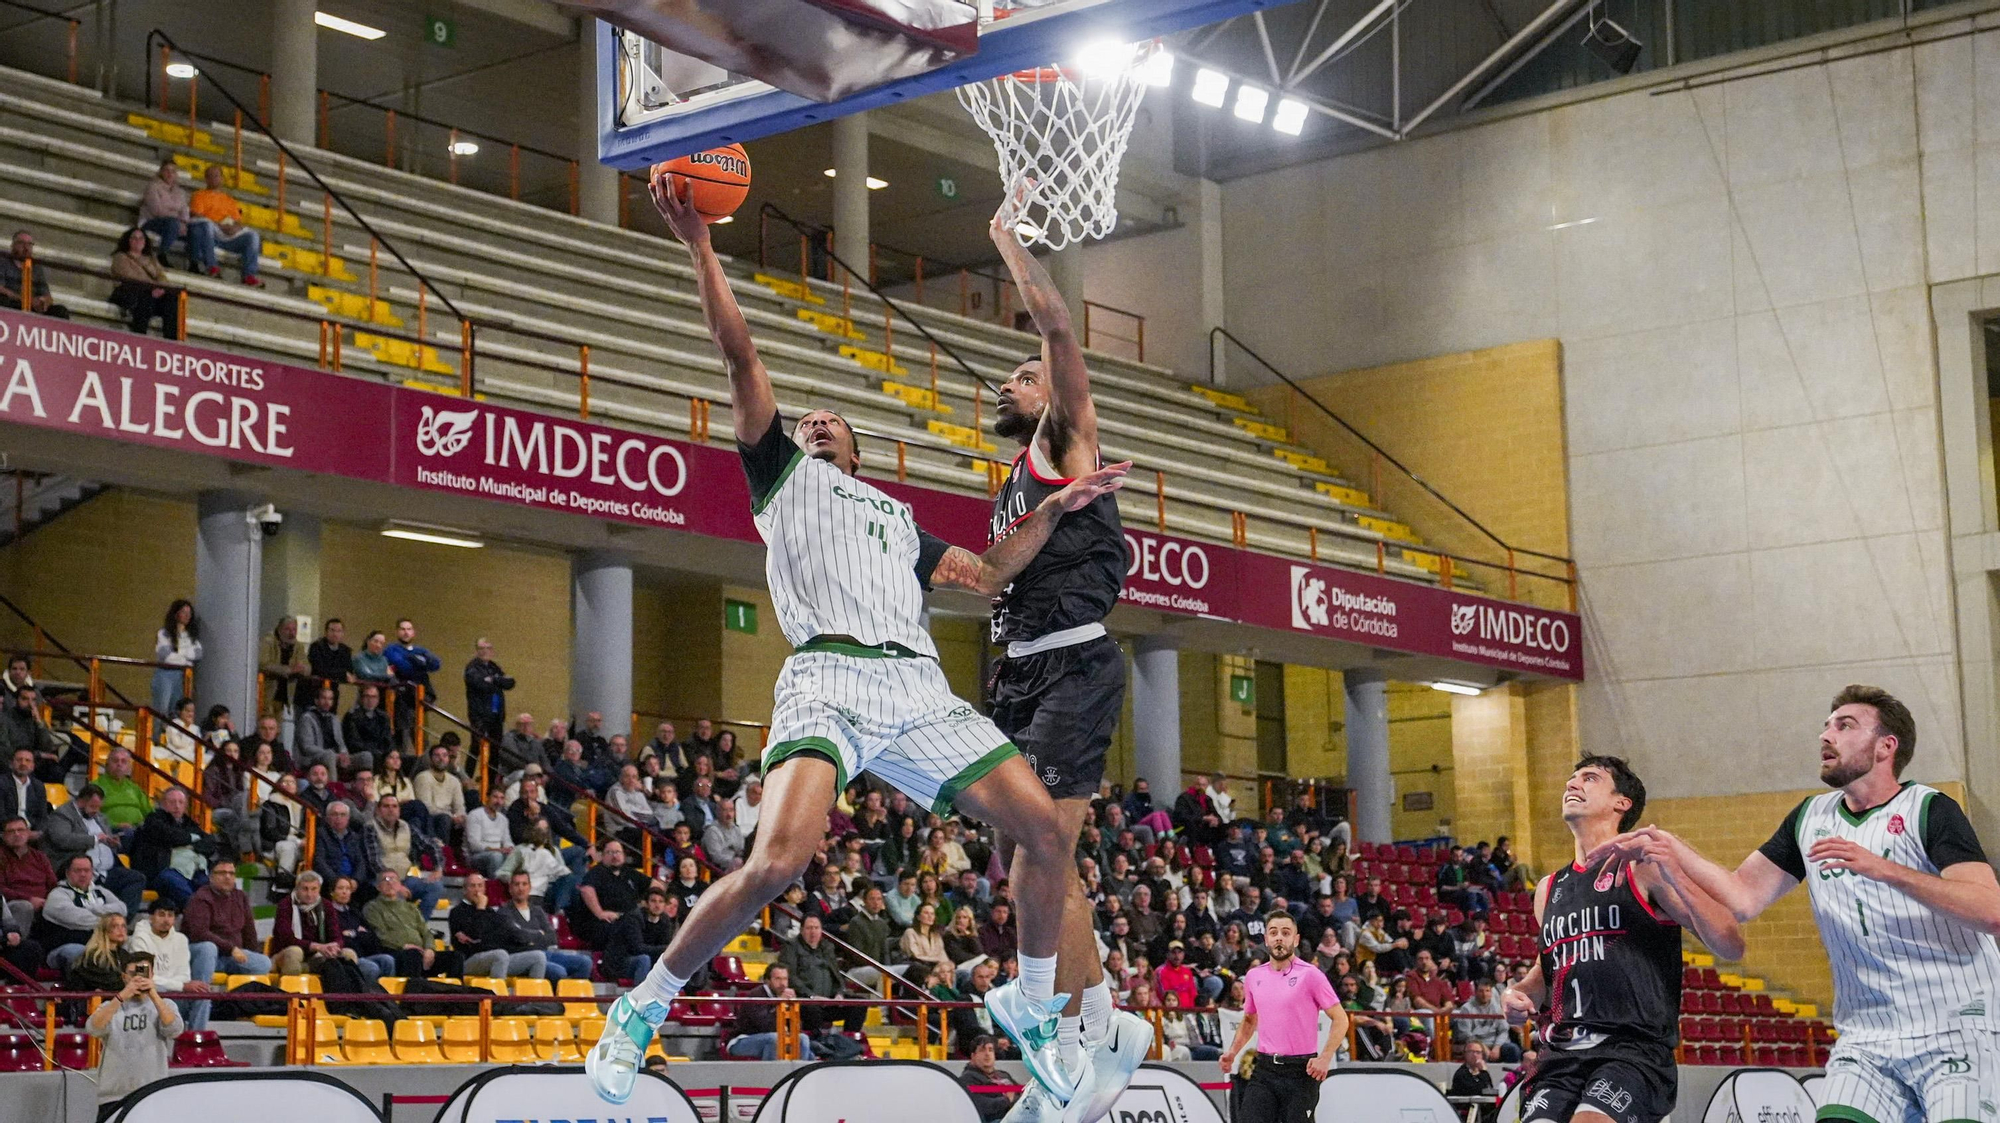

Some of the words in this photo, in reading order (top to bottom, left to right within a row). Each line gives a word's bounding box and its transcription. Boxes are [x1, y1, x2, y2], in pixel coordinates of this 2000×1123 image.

[434, 21, 447, 42] 9
[690, 151, 748, 178] Wilson
[941, 179, 956, 197] 10
[16, 323, 149, 370] MUNICIPAL
[155, 350, 265, 391] DEPORTES
[0, 354, 47, 419] A
[67, 370, 294, 458] ALEGRE
[484, 412, 687, 497] IMDECO
[417, 465, 476, 491] Instituto
[479, 476, 547, 504] Municipal
[549, 489, 567, 507] de
[569, 491, 630, 516] Deportes
[632, 501, 685, 526] Córdoba
[1123, 533, 1210, 589] DECO
[1128, 586, 1170, 607] Deportes
[1171, 593, 1209, 613] Córdoba
[1332, 586, 1397, 616] Diputación
[1333, 610, 1349, 630] de
[1350, 612, 1398, 638] Córdoba
[1479, 605, 1570, 653] IMDECO
[1238, 679, 1248, 699] J
[1855, 898, 1869, 937] 1
[1571, 978, 1583, 1018] 1
